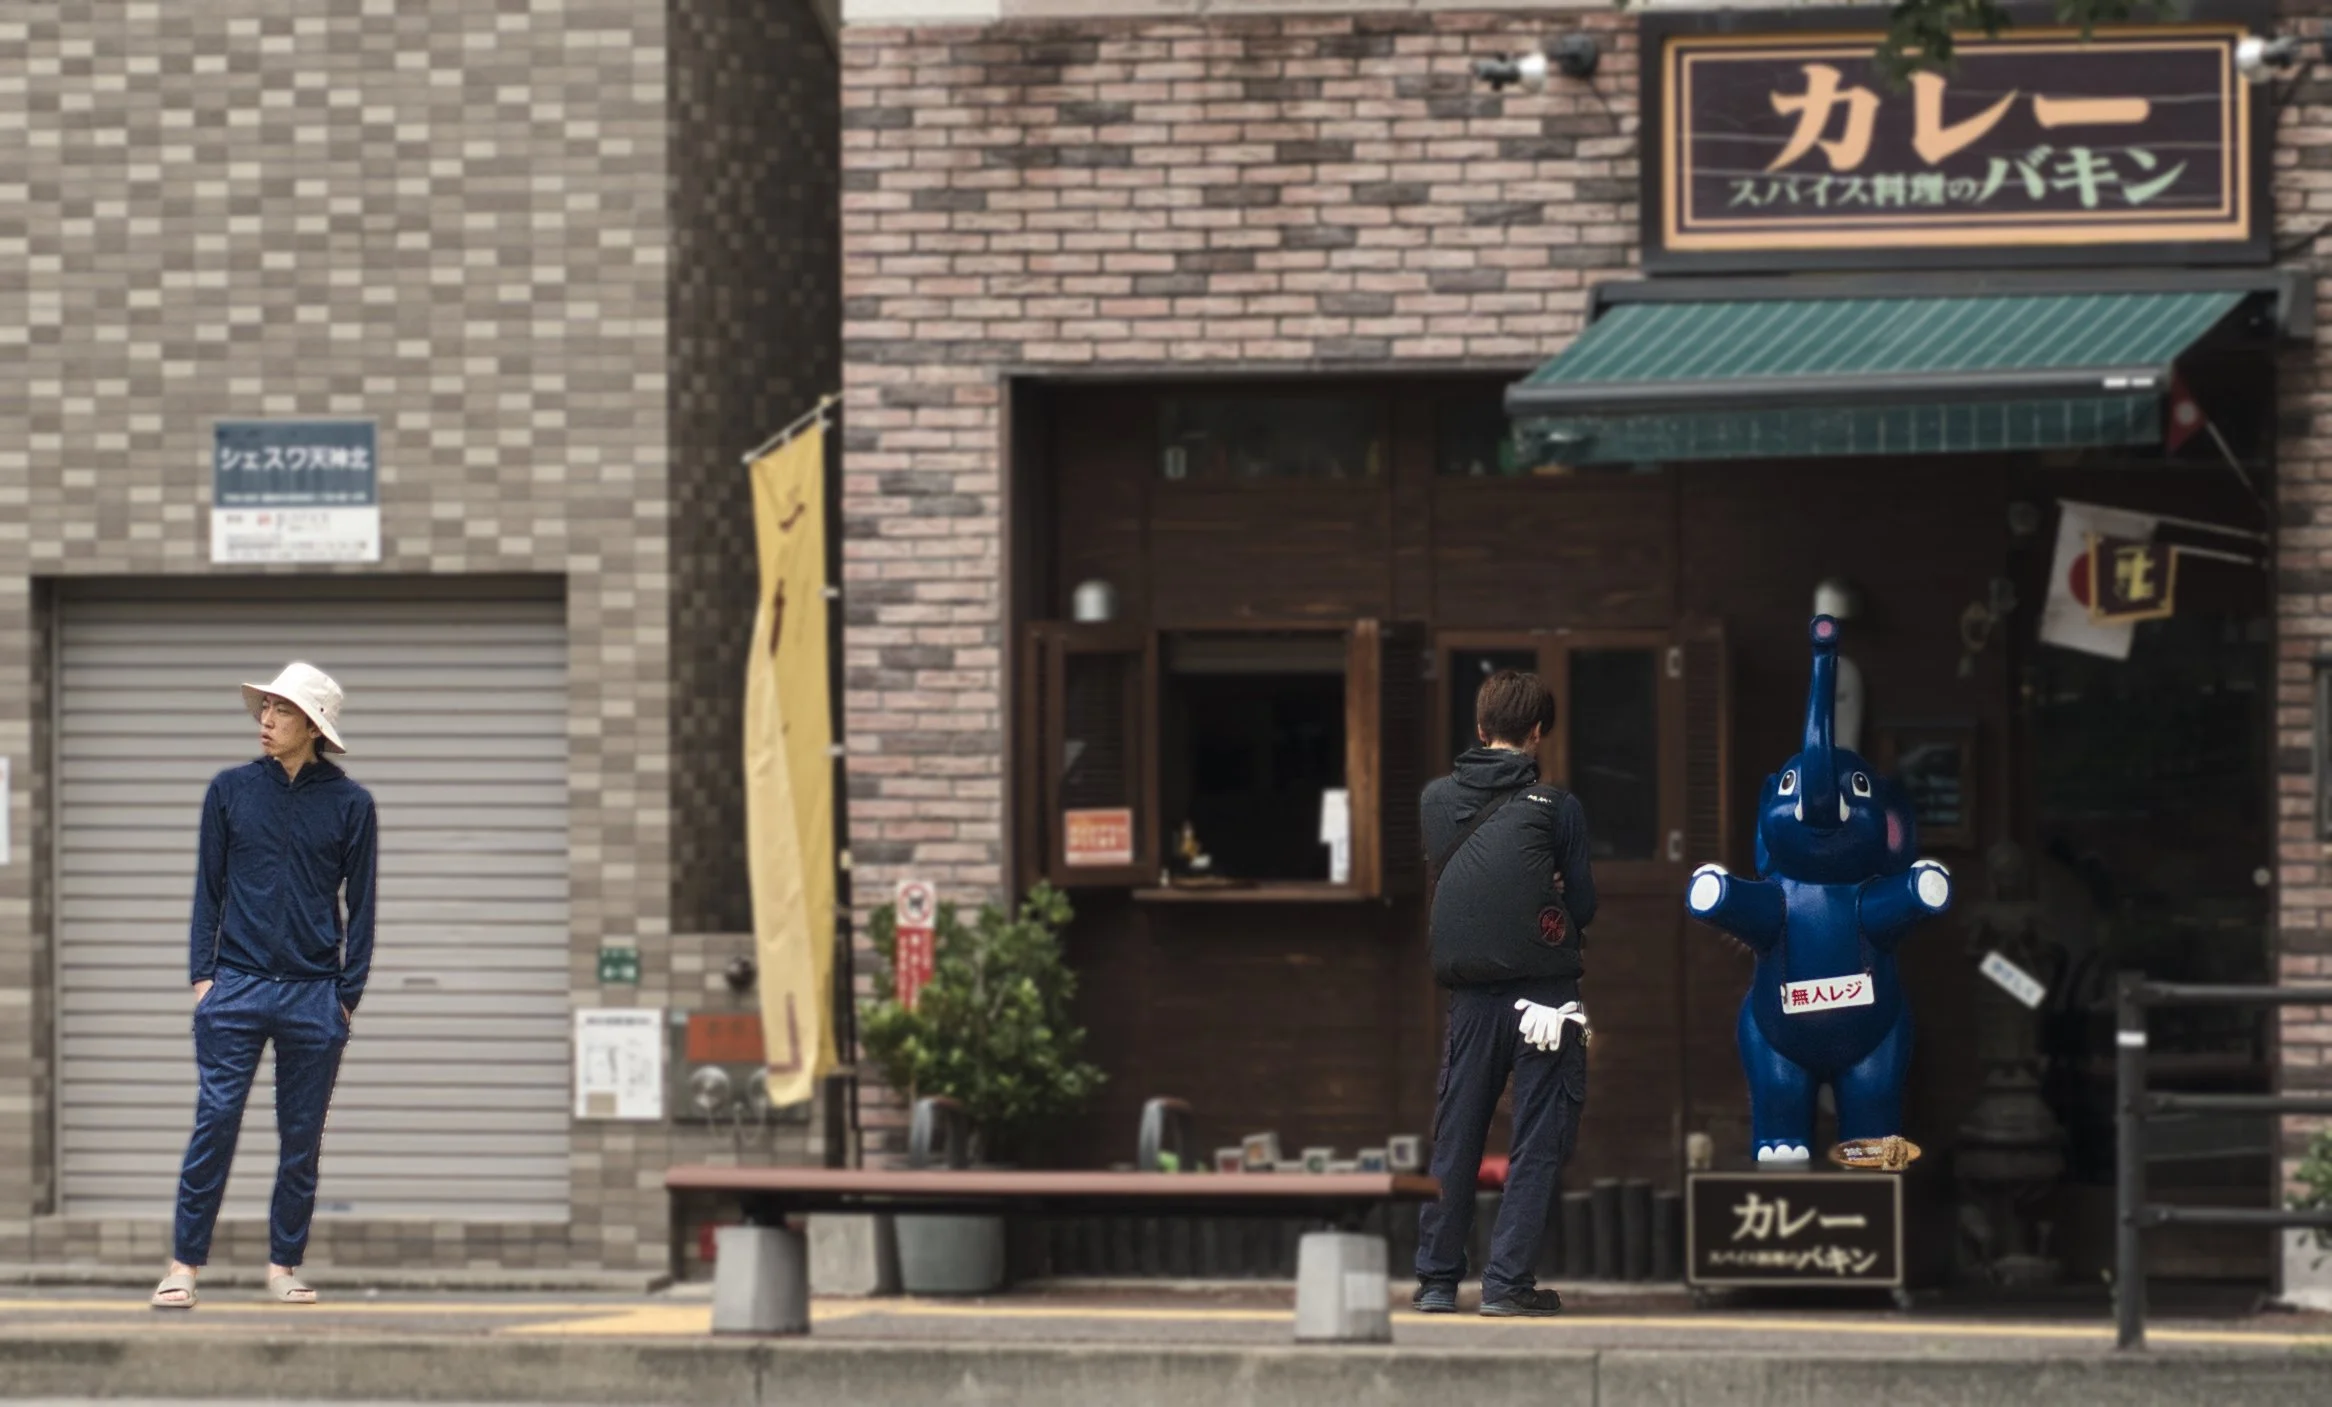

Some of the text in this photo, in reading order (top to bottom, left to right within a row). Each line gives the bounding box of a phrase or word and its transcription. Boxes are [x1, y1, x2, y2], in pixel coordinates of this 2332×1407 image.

[1765, 64, 2150, 171] カレー
[1728, 145, 2188, 208] スパイス料理のバキン
[1791, 980, 1862, 1007] 無人レジ
[1732, 1194, 1867, 1240] カレー
